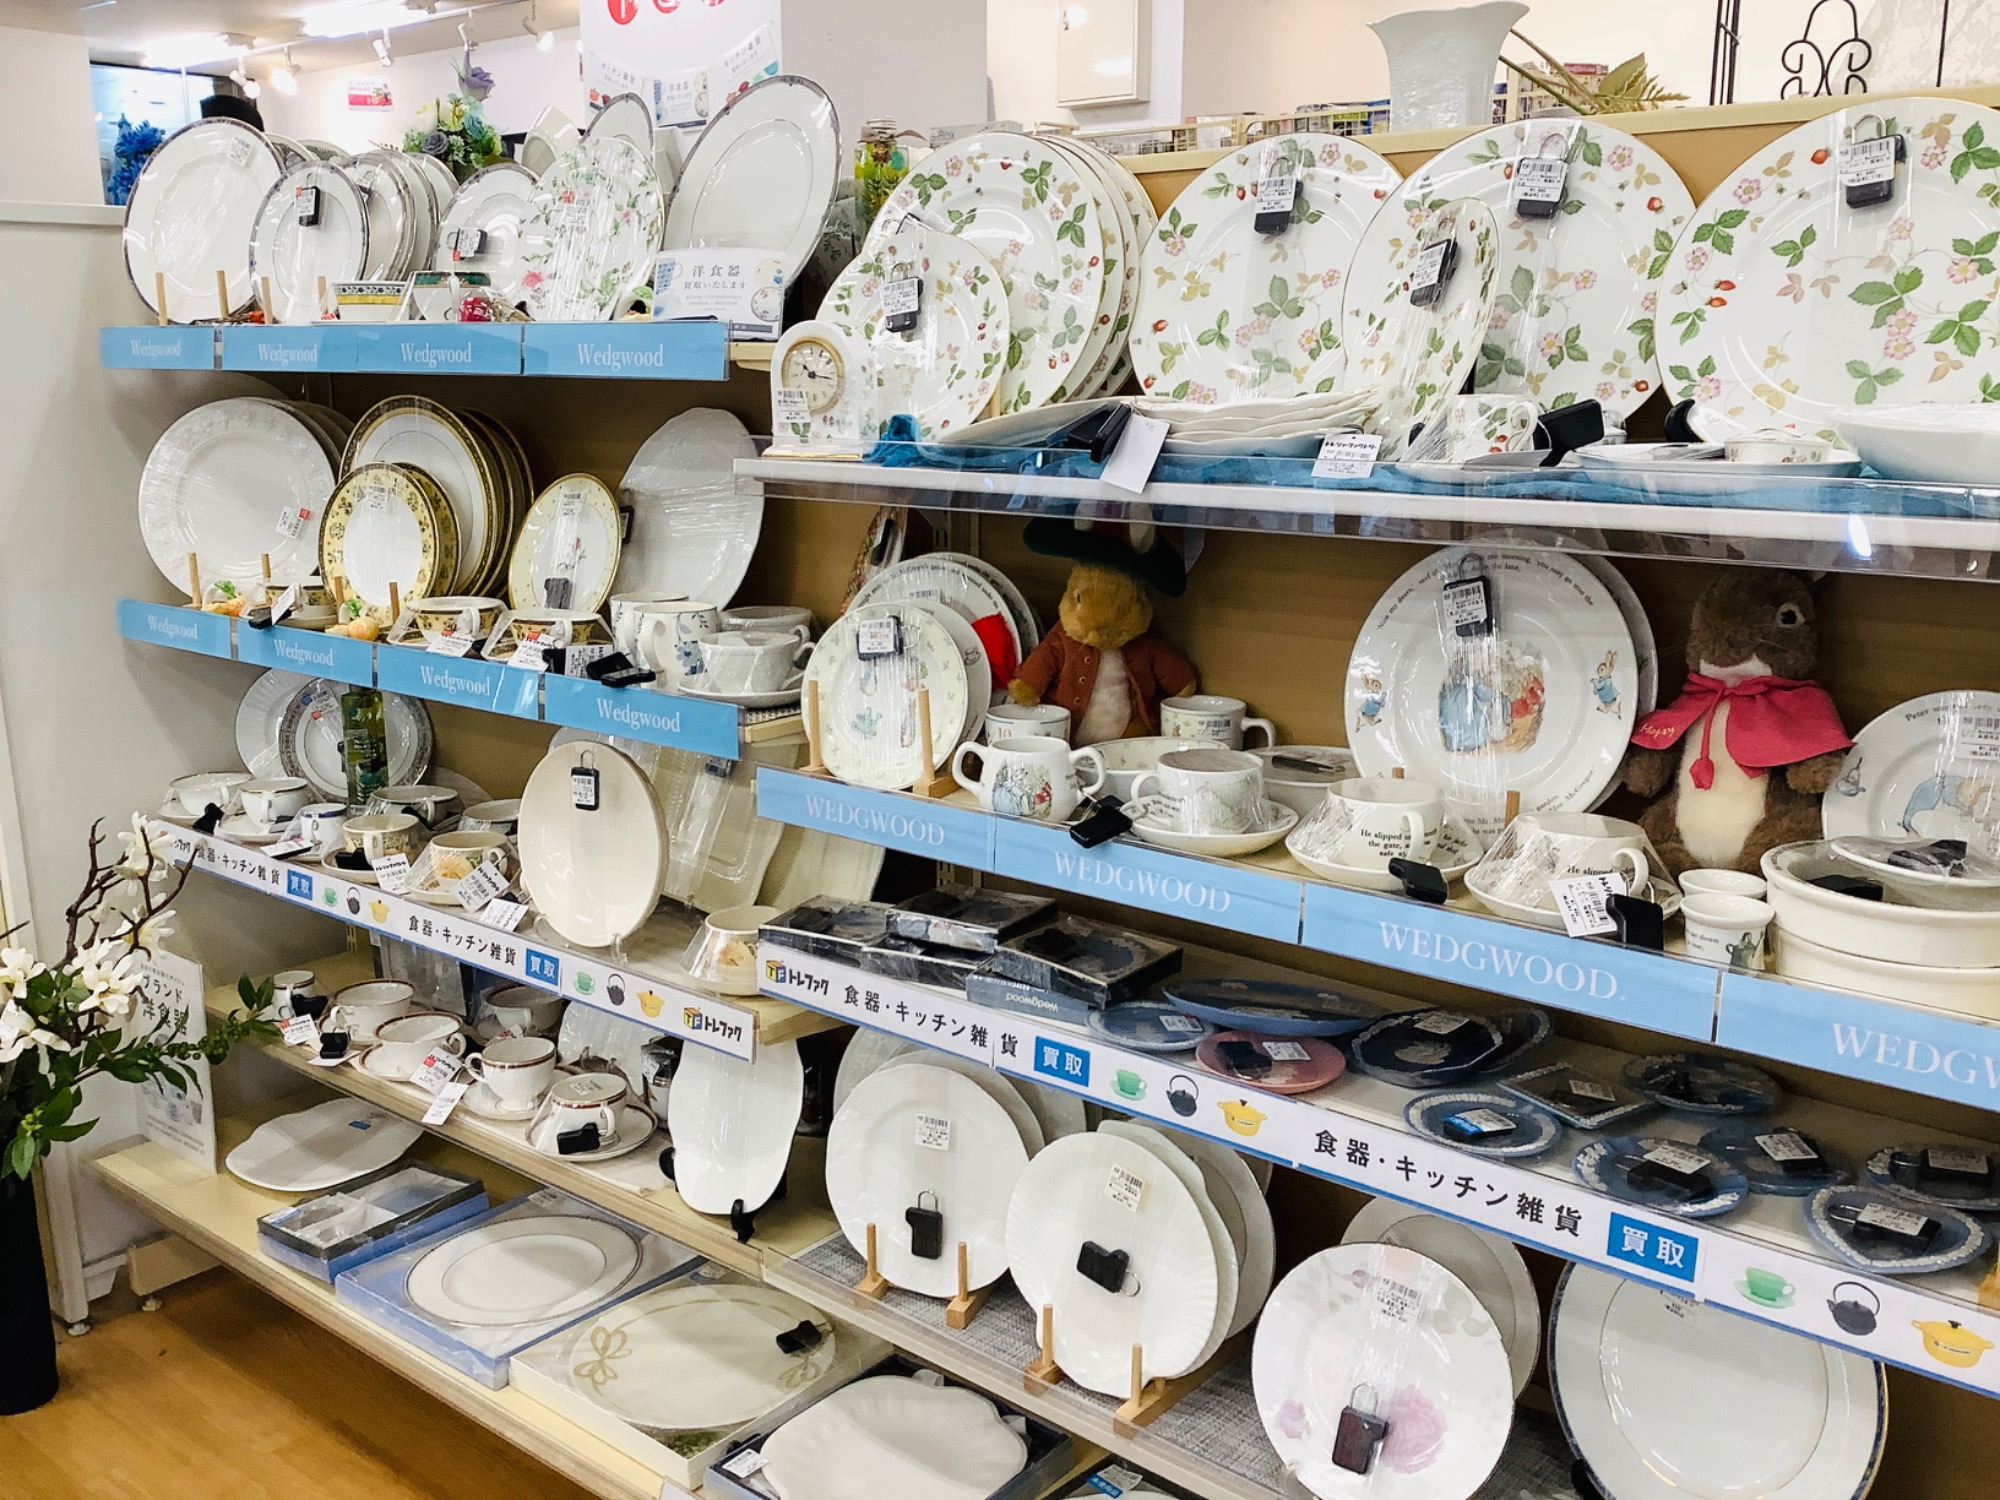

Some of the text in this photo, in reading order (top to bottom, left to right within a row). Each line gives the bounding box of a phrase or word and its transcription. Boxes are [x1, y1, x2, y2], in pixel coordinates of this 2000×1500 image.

[691, 264, 740, 278] 洋食器
[684, 281, 748, 290] 買取いたします
[131, 339, 181, 358] Wedgwood
[258, 342, 318, 365] Wedgwood
[401, 342, 472, 368] Wedgwood
[577, 343, 664, 371] Wedgwood
[147, 615, 198, 640] Wedgwood
[274, 639, 334, 667] Wedgwood
[420, 665, 490, 696] Wedgwood
[597, 697, 680, 732] Wedgwood
[1905, 709, 1930, 722] Peter
[805, 794, 945, 846] WEDGWOOD
[1361, 829, 1372, 838] He
[1374, 832, 1402, 841] slipped
[1384, 841, 1402, 850] gate,
[291, 875, 310, 895] 買取
[1055, 850, 1230, 913] WEDGWOOD
[142, 974, 184, 1003] ブランド
[408, 915, 517, 967] 食器・キッチン雑貨
[530, 956, 556, 980] 買取
[705, 1016, 742, 1042] トレファク
[1005, 993, 1059, 1013] Wedgwood
[789, 968, 829, 995] トレファク
[844, 984, 1018, 1057] 食器・キッチン雑貨
[1042, 1047, 1083, 1077] 買取
[1314, 1128, 1684, 1269] 食器・キッチン雑貨 買取
